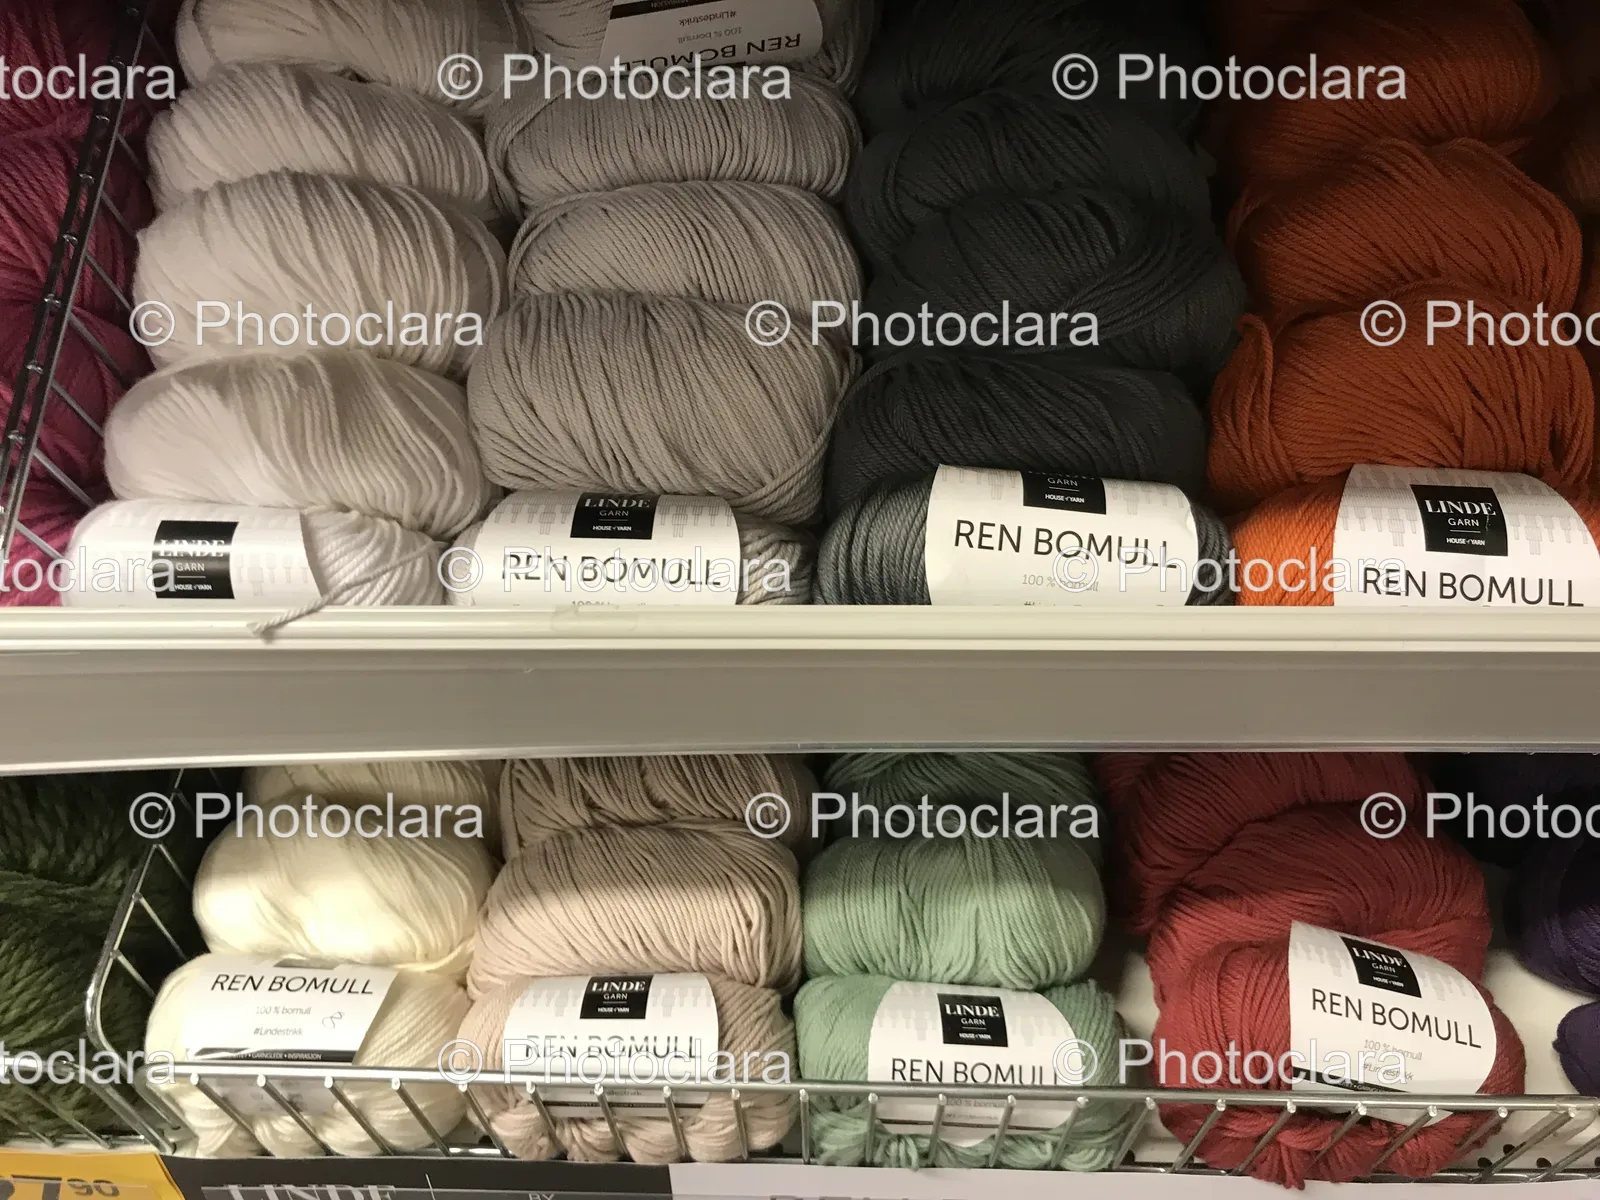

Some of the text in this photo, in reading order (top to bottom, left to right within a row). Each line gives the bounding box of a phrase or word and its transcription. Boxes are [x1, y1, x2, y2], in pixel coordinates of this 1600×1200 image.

[746, 33, 801, 55] REN
[1047, 477, 1078, 486] GARN
[585, 498, 651, 508] LINDE
[1045, 493, 1064, 501] HOUSE
[1425, 500, 1496, 516] LINDE
[1448, 518, 1479, 526] GARN
[954, 519, 1177, 569] REN BOMULL
[175, 562, 205, 571] GARN
[502, 553, 722, 586] REN BOMULL
[1022, 574, 1044, 586] 100
[1363, 567, 1585, 607] REN BOMULL
[1352, 947, 1407, 968] LINDE
[1372, 962, 1396, 973] GARN
[211, 973, 374, 995] REN BOMULL
[592, 981, 646, 992] LINDE
[256, 1006, 271, 1015] 100
[281, 1006, 312, 1015] bomull
[945, 1004, 1000, 1018] LINDE
[1312, 988, 1482, 1049] REN BOMULL
[253, 1027, 303, 1036] #Lindestrikk
[1364, 1039, 1380, 1051] 100
[891, 1057, 944, 1082] REN
